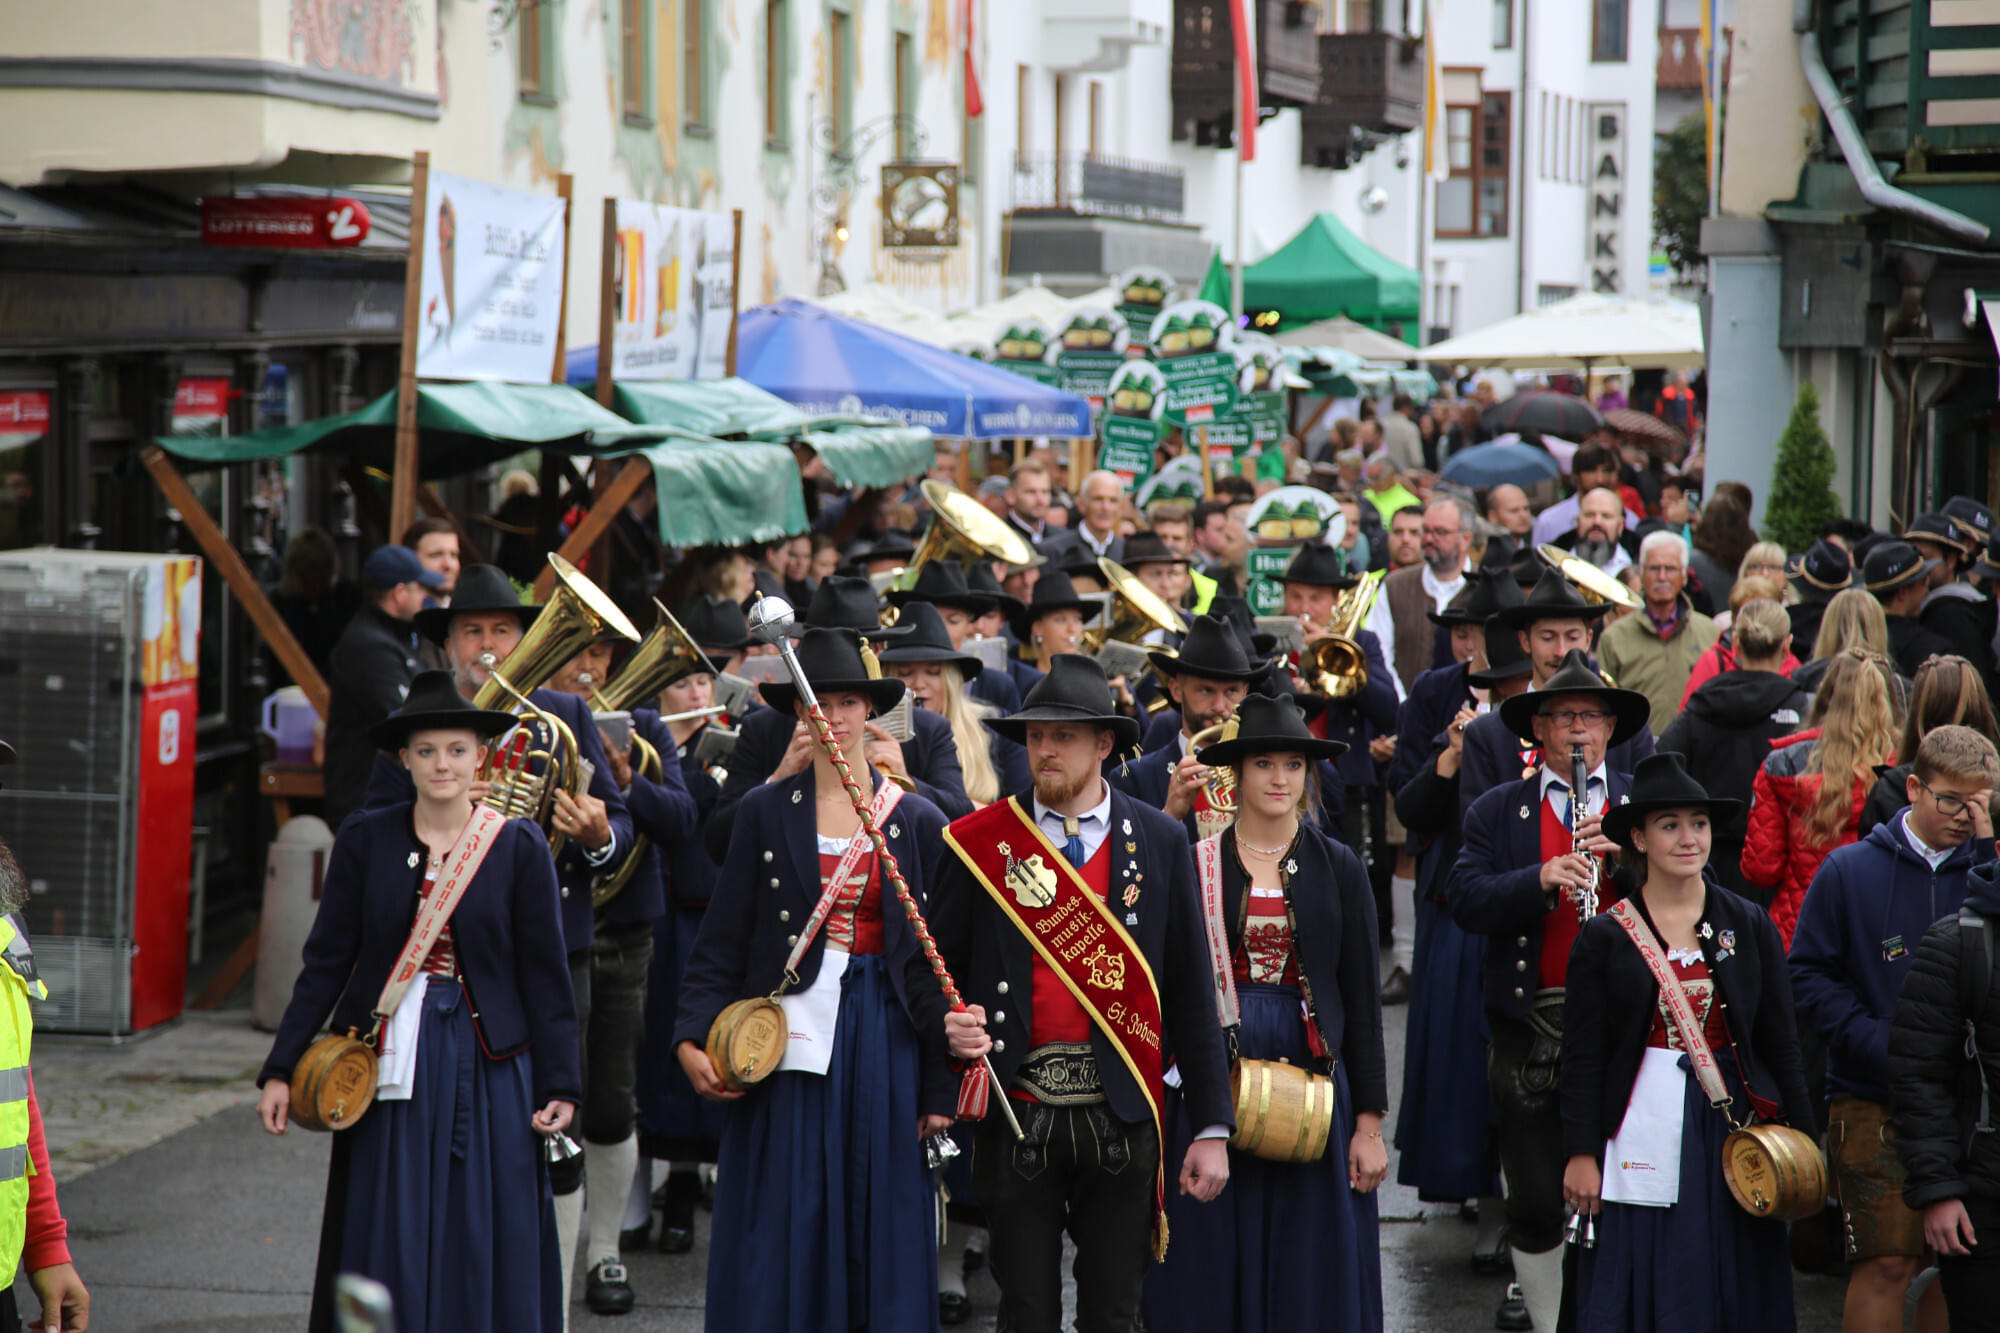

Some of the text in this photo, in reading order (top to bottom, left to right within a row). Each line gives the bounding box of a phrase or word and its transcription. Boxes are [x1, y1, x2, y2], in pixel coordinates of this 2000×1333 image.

[1035, 895, 1083, 935] Bundes-
[1051, 910, 1095, 948] musik-
[1059, 923, 1106, 963] kapelle
[1107, 1001, 1160, 1050] St. Johann
